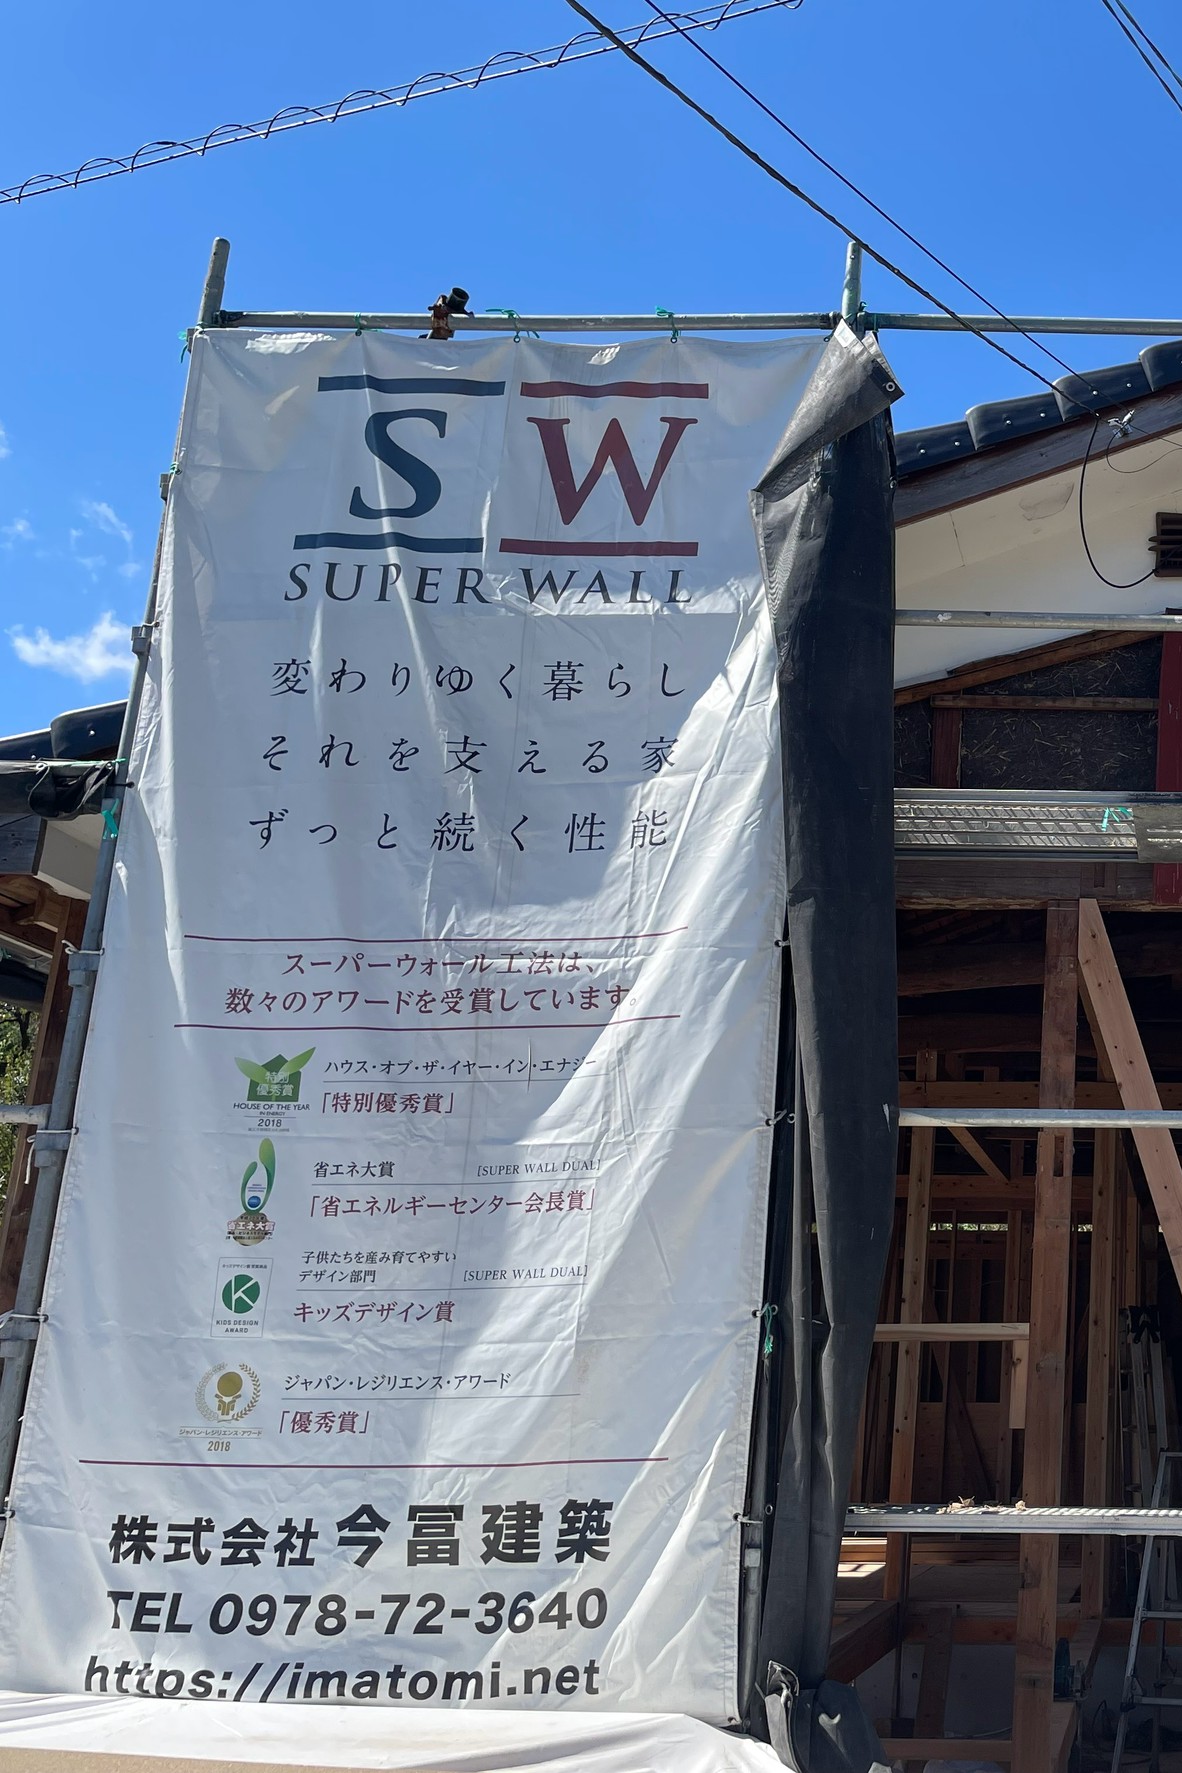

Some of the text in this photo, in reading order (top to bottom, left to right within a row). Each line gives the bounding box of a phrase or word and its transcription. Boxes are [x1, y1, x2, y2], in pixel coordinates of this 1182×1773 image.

[283, 562, 694, 606] SUPER WALL
[271, 658, 687, 702] 変わりゆく暮らし
[260, 733, 680, 774] それを支える家
[248, 808, 670, 853] ずっと続く性能
[281, 951, 596, 976] スーパーウォール工法は、
[224, 984, 638, 1015] 数々のアワードを受賞しています。
[233, 1102, 262, 1110] HOUSE
[277, 1103, 292, 1111] THE
[293, 1103, 310, 1111] YEAR
[321, 1091, 455, 1114] 「特別優秀賞」
[257, 1118, 282, 1127] 2018
[313, 1161, 396, 1179] 省エネ大賞
[524, 1162, 559, 1174] WALL
[309, 1187, 596, 1217] 「省エネルギーセンター会長賞」
[301, 1250, 457, 1265] 子供たちを産み育てやすい
[298, 1269, 377, 1284] デザイン部門
[512, 1267, 547, 1280] WALL
[293, 1300, 456, 1323] キッズデザイン賞
[284, 1372, 512, 1392] ジャパン・レジリエンス・アワード
[279, 1409, 371, 1434] 「優秀賞」
[207, 1440, 231, 1452] 2018
[107, 1514, 319, 1569] 株式会社
[107, 1587, 608, 1636] TEL 0978-72-3640
[84, 1656, 601, 1703] https://imatomi.net
